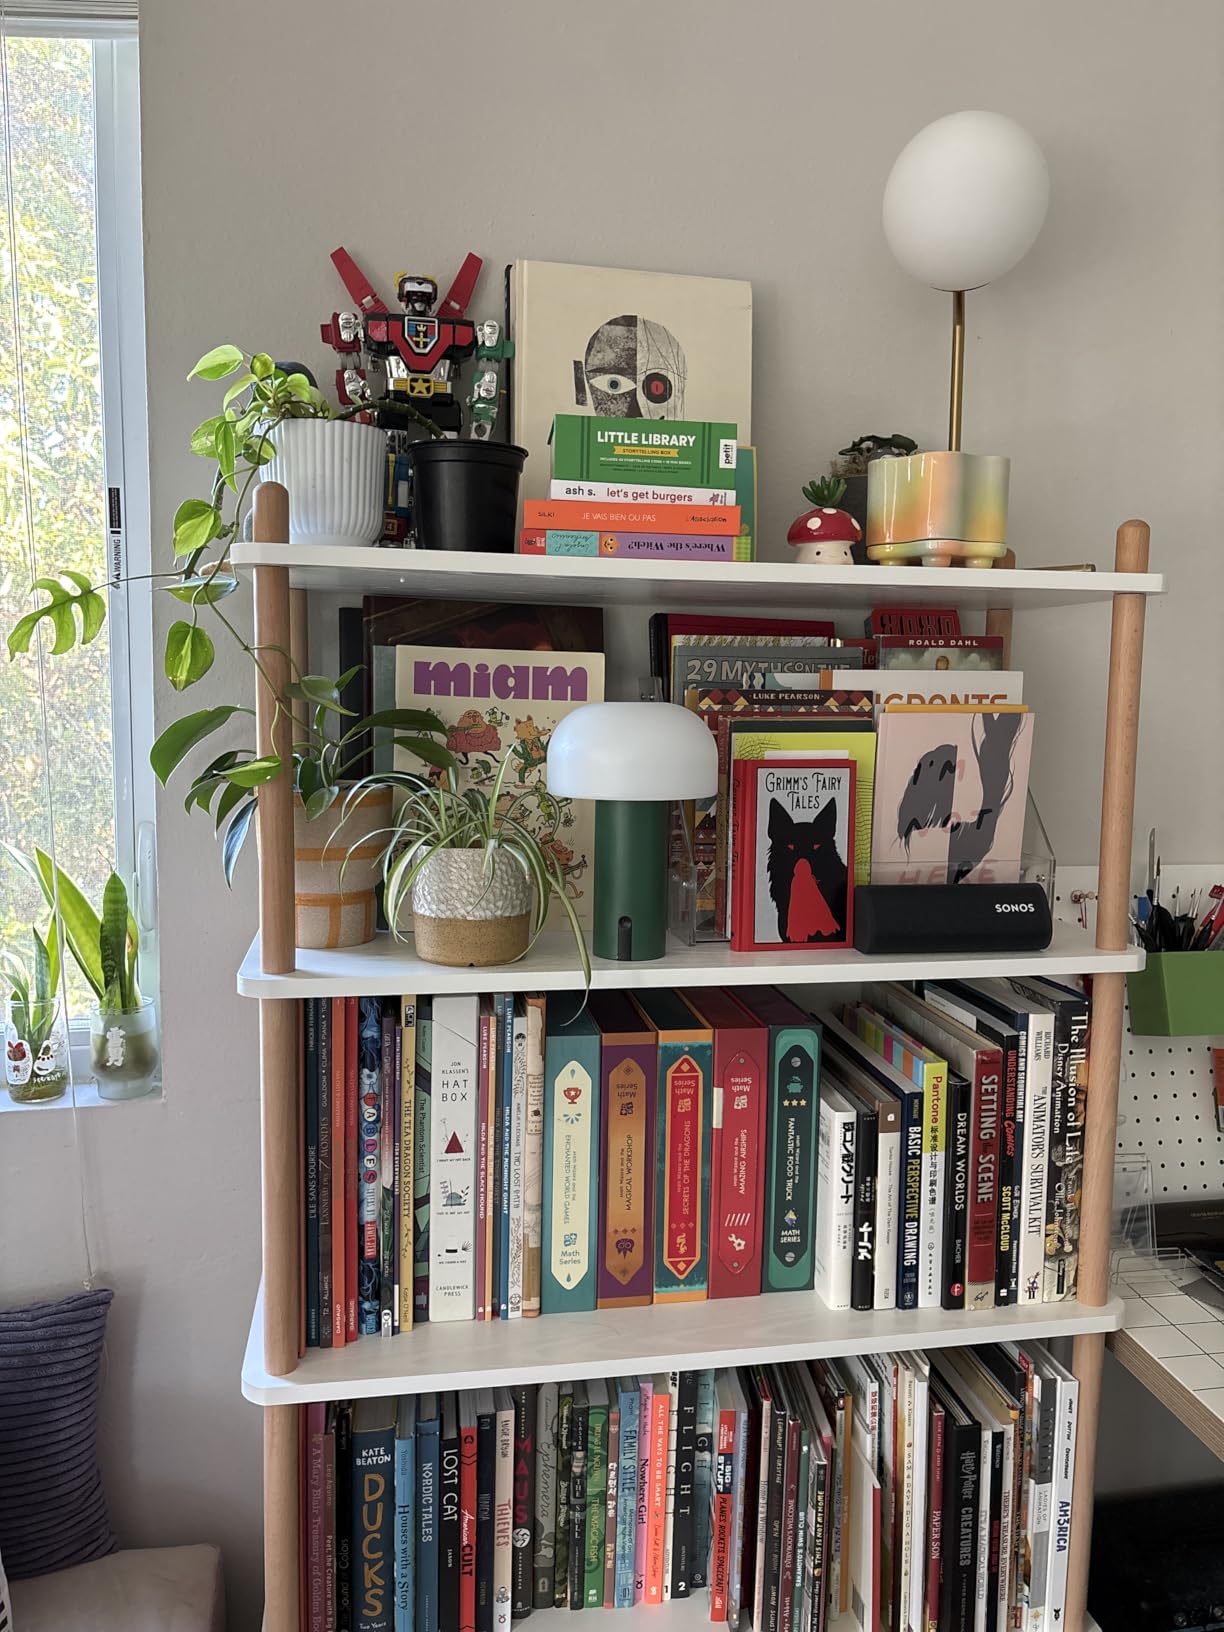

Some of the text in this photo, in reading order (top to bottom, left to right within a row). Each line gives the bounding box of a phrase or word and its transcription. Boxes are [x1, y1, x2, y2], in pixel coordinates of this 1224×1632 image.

[597, 431, 696, 447] LITTLE LIBRARY
[723, 444, 732, 464] petit
[565, 486, 585, 495] ash
[606, 488, 693, 503] let's get burgers
[592, 513, 608, 521] VAIS
[609, 513, 627, 521] BIEN
[628, 514, 640, 522] OU
[642, 514, 657, 522] PAS
[627, 541, 726, 552] Where's the Witch?
[414, 660, 588, 702] miam
[765, 772, 842, 794] GRIMM'S FAIRY
[788, 790, 820, 811] TALES
[994, 903, 1035, 912] SONOS
[1034, 1031, 1042, 1061] WILLIAMS
[1043, 1032, 1051, 1059] RICHARD
[442, 1080, 468, 1088] HAT
[1006, 1050, 1017, 1118] UNDERSTANDING
[1016, 1031, 1027, 1122] COMICS AND SEQUENTIAL ART
[1053, 1043, 1069, 1134] Disney Animation
[1066, 1011, 1088, 1165] The Illusion of Life
[442, 1092, 467, 1102] BOX
[932, 1076, 942, 1124] Pantone
[363, 1092, 378, 1184] FABLES
[418, 1113, 426, 1142] Phantom
[908, 1126, 921, 1156] BASIC
[1031, 1095, 1046, 1159] ANIMATOR'S
[403, 1140, 411, 1178] DRAGON
[954, 1113, 967, 1210] DREAM WORLDS
[683, 1175, 690, 1184] OF
[785, 1179, 793, 1200] TRUCK
[905, 1159, 920, 1219] PERSPECTIVE
[1029, 1164, 1044, 1215] SURVIVAL
[1055, 1182, 1065, 1208] Ollie
[1000, 1186, 1011, 1251] SCOTT McCLOUD
[1028, 1217, 1041, 1235] KIT
[904, 1221, 918, 1266] DRAWING
[356, 1454, 391, 1466] BEATON
[362, 1447, 385, 1457] KATE
[622, 1430, 636, 1492] FAMILY STYLE
[656, 1458, 662, 1467] TO
[680, 1406, 694, 1516] FLIGHT
[443, 1449, 458, 1521] LOST CAT
[514, 1435, 532, 1524] MAUS
[537, 1442, 554, 1518] Ephemera
[638, 1458, 648, 1524] Nowhere Girl
[656, 1470, 661, 1479] BE
[422, 1462, 432, 1542] NORDIC TALES
[591, 1498, 599, 1512] THE
[719, 1497, 727, 1522] PLANES
[817, 1513, 823, 1523] MY
[960, 1451, 977, 1566] Harry Potter CREATURES
[398, 1504, 410, 1545] Houses
[496, 1498, 511, 1547] THIEVES
[718, 1525, 726, 1553] ROCKETS
[931, 1510, 941, 1559] PAPER SON
[1056, 1501, 1070, 1552] AM3RICA
[362, 1473, 386, 1617] DUCKS
[400, 1547, 411, 1570] with
[462, 1509, 475, 1576] American CULT
[784, 1531, 792, 1568] EVERYBODY'S
[795, 1549, 804, 1587] SAKAMOTO'S
[398, 1581, 410, 1611] Story
[678, 1582, 686, 1591] 2
